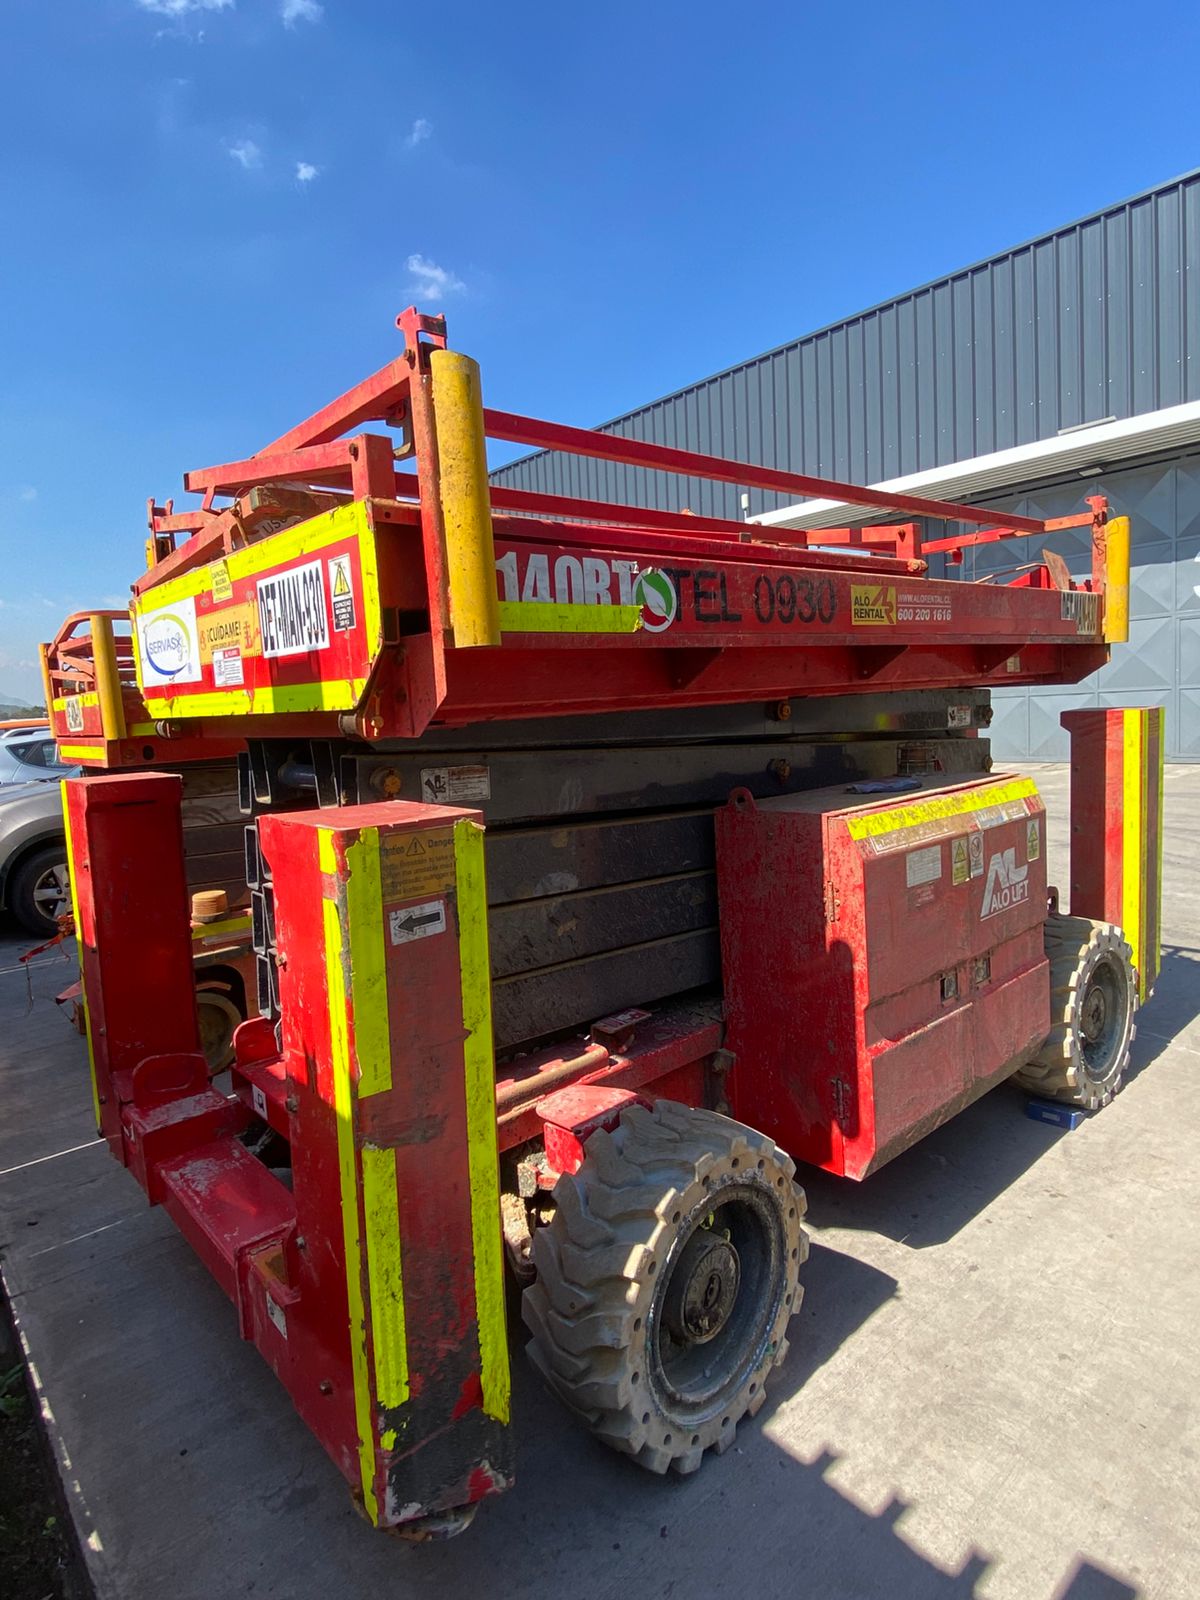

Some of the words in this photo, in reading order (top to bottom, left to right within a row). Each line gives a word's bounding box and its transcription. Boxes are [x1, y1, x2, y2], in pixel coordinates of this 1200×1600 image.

[661, 568, 742, 622] TEL
[754, 574, 836, 624] 0930
[854, 608, 885, 619] RENTAL
[897, 608, 913, 620] 600
[915, 608, 930, 620] 200
[933, 608, 952, 620] 1616
[991, 888, 1010, 913] ALO
[1012, 880, 1029, 902] LIFT
